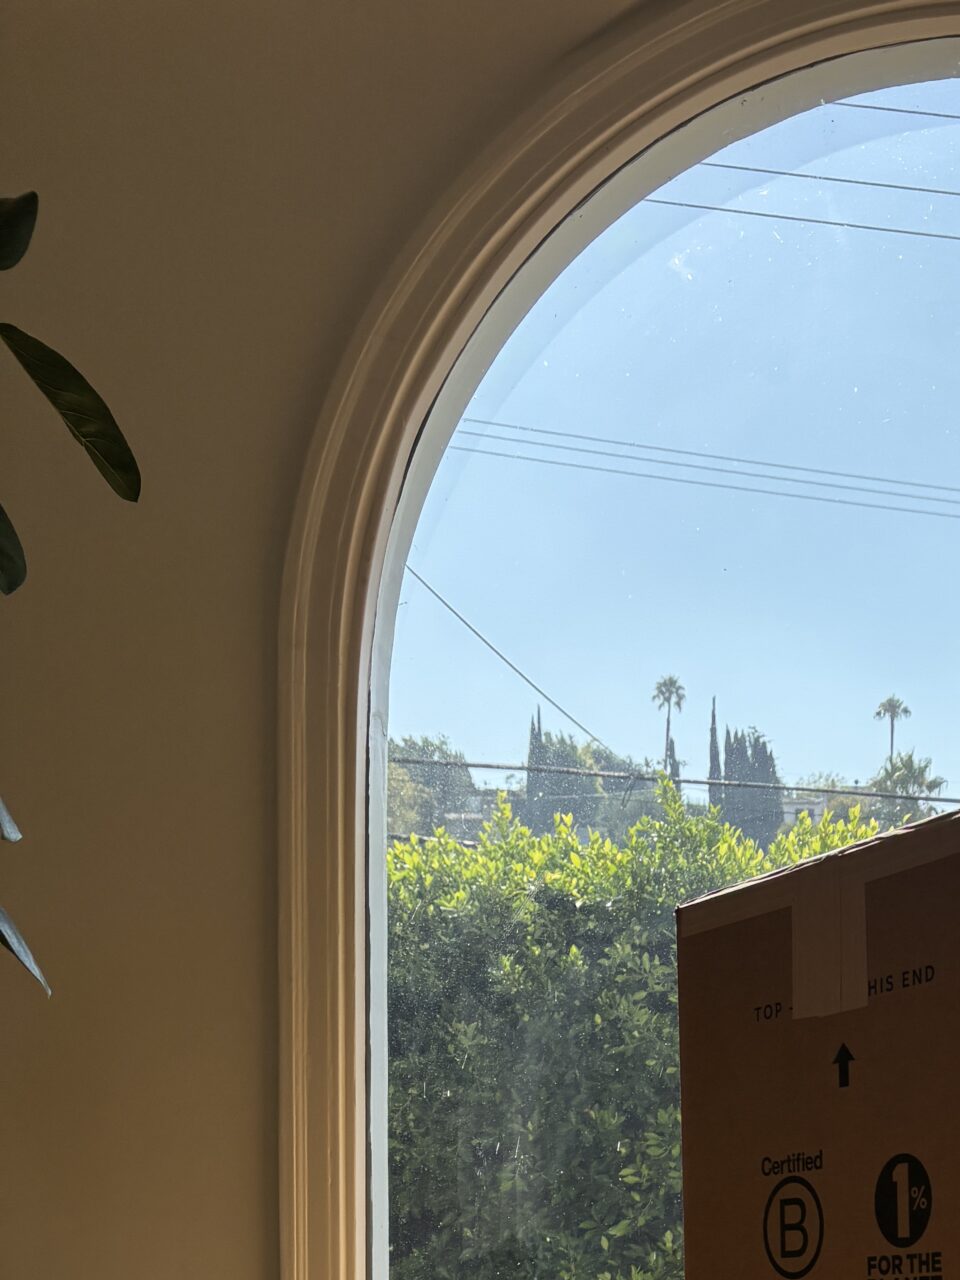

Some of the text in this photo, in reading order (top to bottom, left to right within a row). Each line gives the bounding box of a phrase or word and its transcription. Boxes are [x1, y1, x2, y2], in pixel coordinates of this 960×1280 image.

[754, 965, 935, 1022] TOP HIS END
[762, 1150, 823, 1176] Certified
[780, 1198, 808, 1258] B
[867, 1252, 942, 1276] FOR THE
